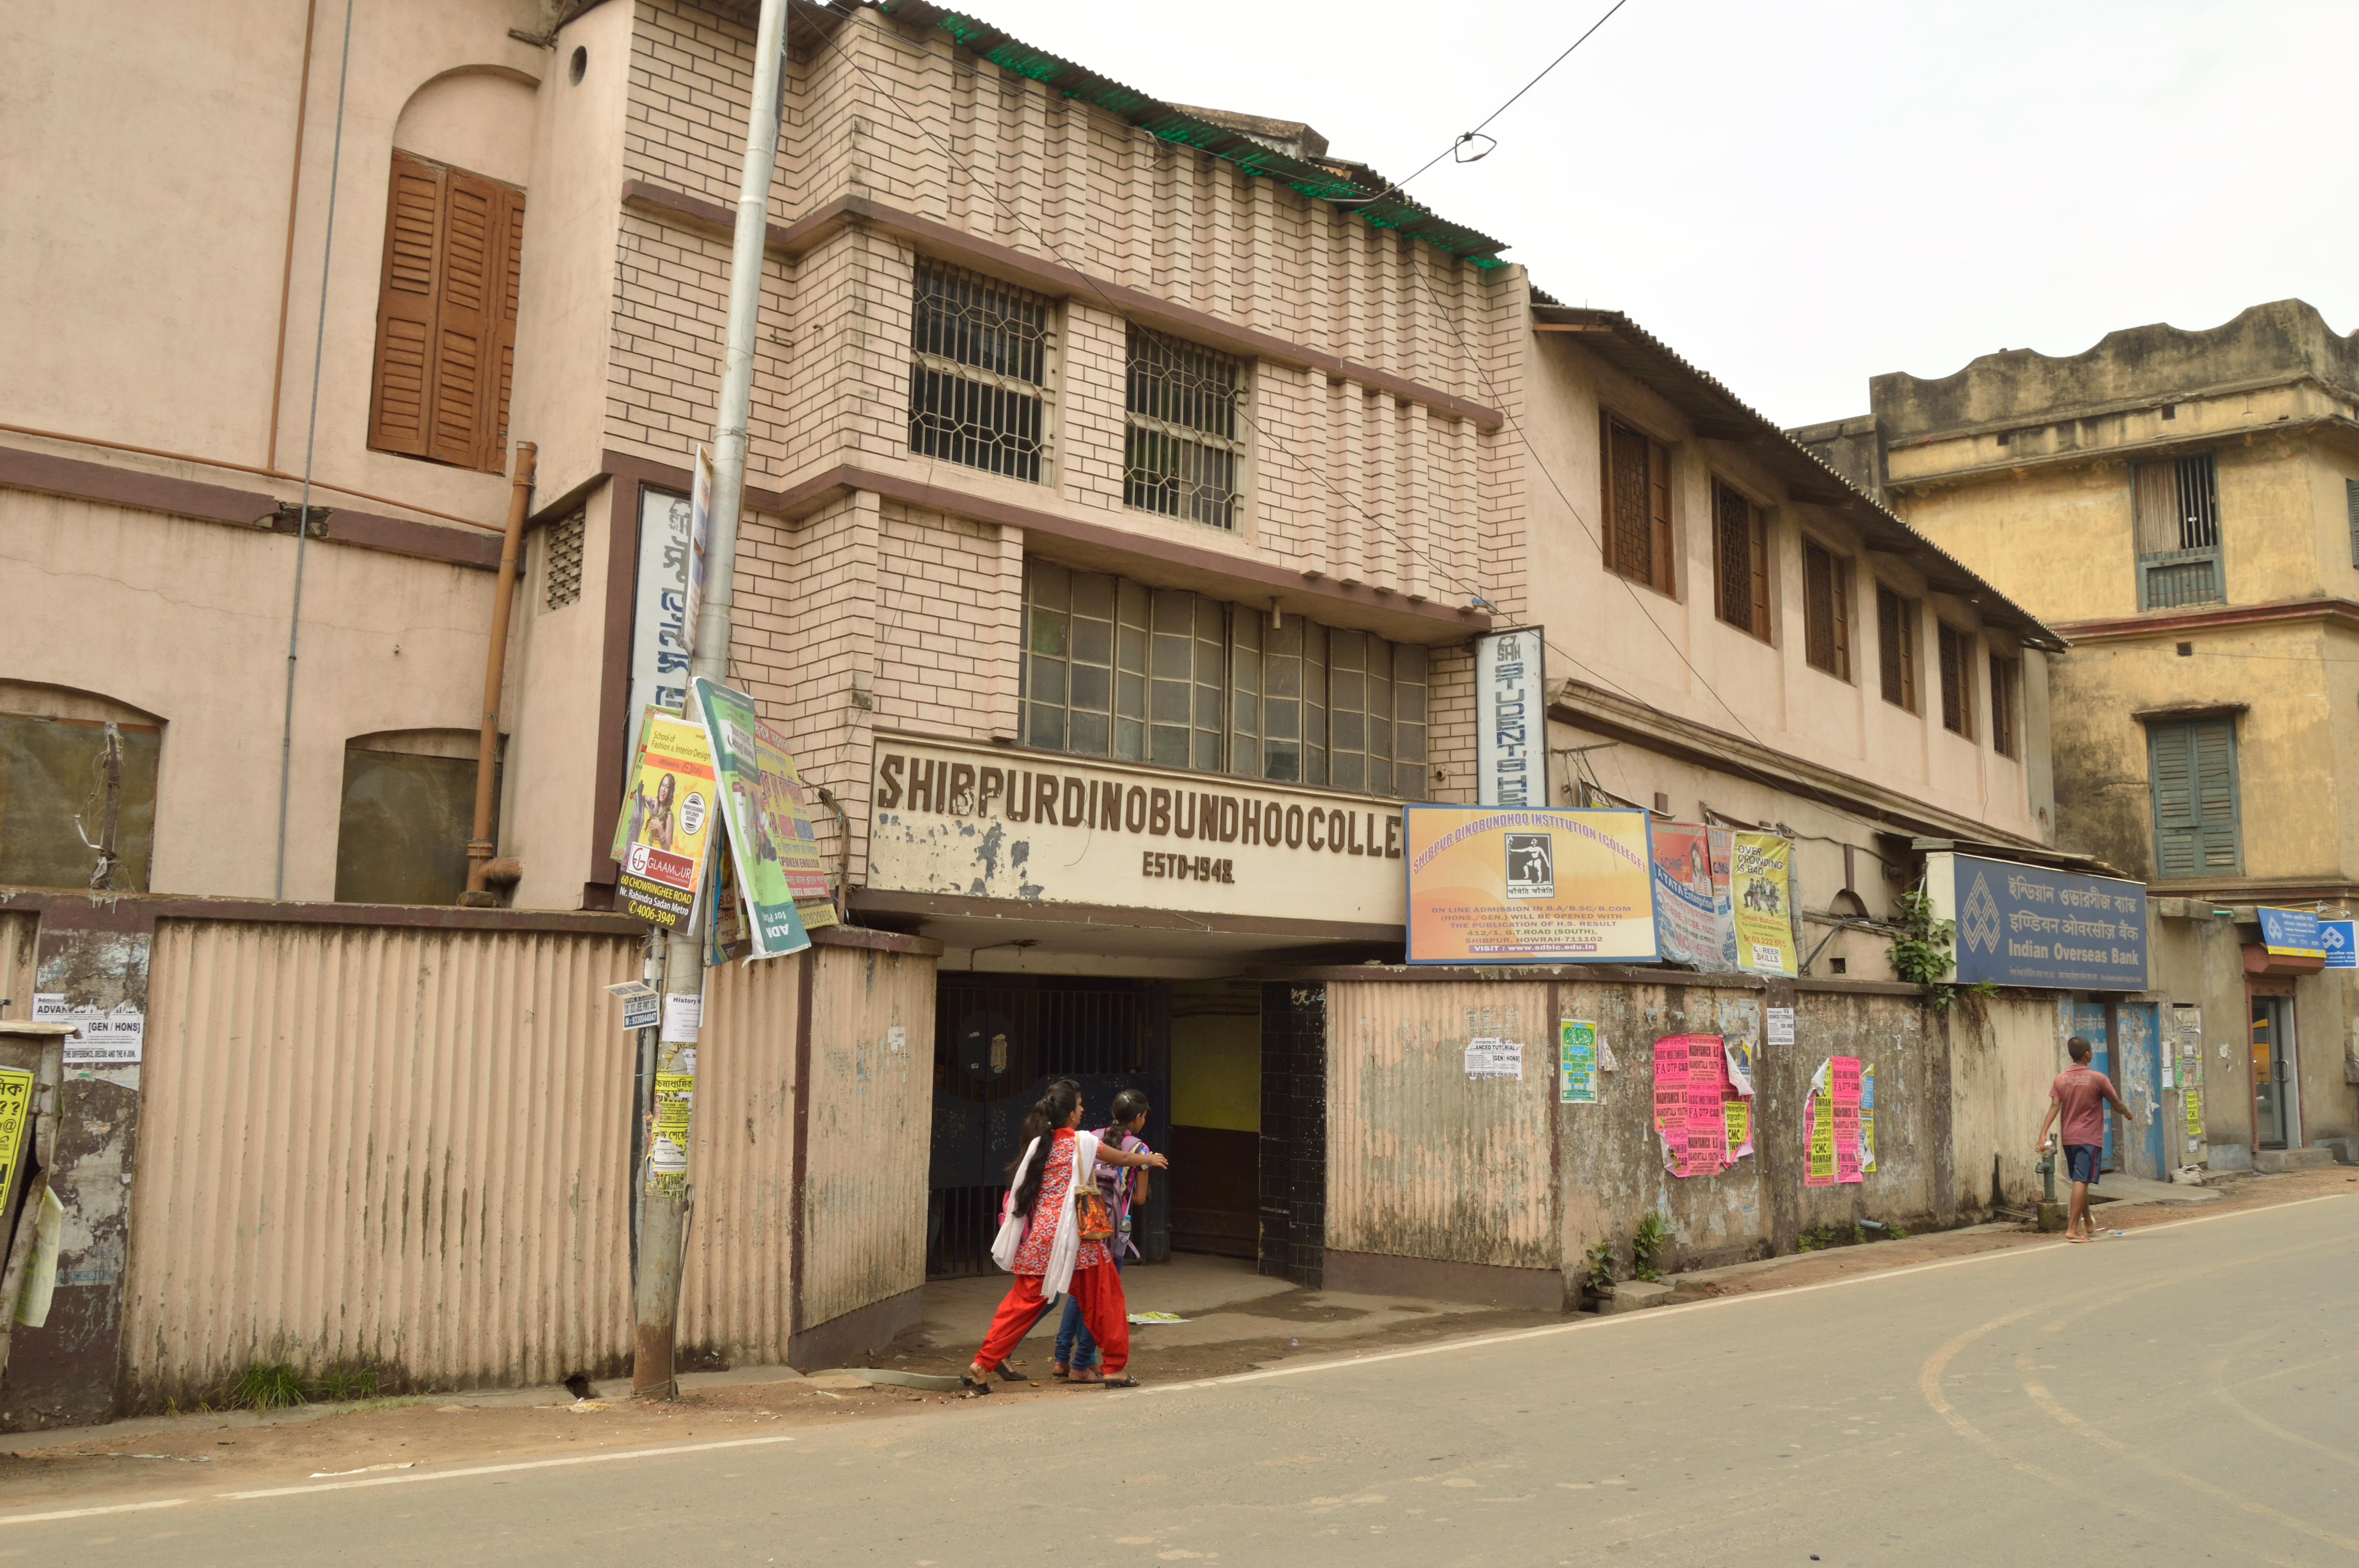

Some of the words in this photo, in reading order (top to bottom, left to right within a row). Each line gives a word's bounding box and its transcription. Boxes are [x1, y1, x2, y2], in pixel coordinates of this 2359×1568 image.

[653, 731, 669, 742] School
[651, 740, 670, 751] Fashion
[675, 745, 694, 756] Interior
[693, 749, 711, 761] Design
[692, 766, 703, 776] Italy
[683, 804, 704, 814] PROFESSIONAL
[1412, 832, 1454, 874] SHIBPUR
[1455, 813, 1529, 842] DINOBUNDHOO
[1531, 813, 1597, 842] INSTITUTION
[1598, 832, 1647, 875] (COLLEGE)
[1738, 845, 1762, 856] OVER
[778, 856, 800, 868] SPOKEN
[799, 858, 820, 869] ENGLISH
[1738, 854, 1783, 869] CROWDING
[647, 857, 691, 879] GLAAMOUR
[1737, 864, 1745, 872] IS
[1747, 866, 1763, 876] BAD
[621, 875, 629, 885] 60
[629, 877, 672, 899] CHOWRINGHEE
[673, 891, 692, 905] ROAD
[1658, 867, 1663, 880] A
[1662, 873, 1684, 898] TATA
[1684, 887, 1714, 909] Enterprise
[629, 889, 652, 905] Rabindra
[653, 897, 671, 910] Sadan
[671, 902, 689, 916] Metro
[636, 904, 676, 926] 4006-3949
[775, 911, 787, 920] for
[2118, 919, 2139, 941] बैंक
[1761, 937, 1773, 946] 222
[1754, 946, 1780, 956] CAREER
[2008, 938, 2049, 959] Indian
[2054, 942, 2108, 963] Overseas
[2111, 947, 2139, 965] Bank
[1756, 953, 1779, 963] SKILLS
[673, 997, 696, 1005] History
[625, 1017, 629, 1026] M
[632, 1012, 657, 1025] 9330044047
[88, 1022, 108, 1033] [GEN
[115, 1022, 140, 1034] HONS]
[1667, 1062, 1677, 1073] DTP
[1678, 1062, 1688, 1073] CAD
[1815, 1098, 1831, 1107] OWRAH
[1699, 1108, 1708, 1118] DTP
[1710, 1108, 1719, 1118] CAD
[1728, 1129, 1740, 1140] CMC
[1815, 1143, 1826, 1154] CMC
[1812, 1154, 1831, 1164] HOWRAH
